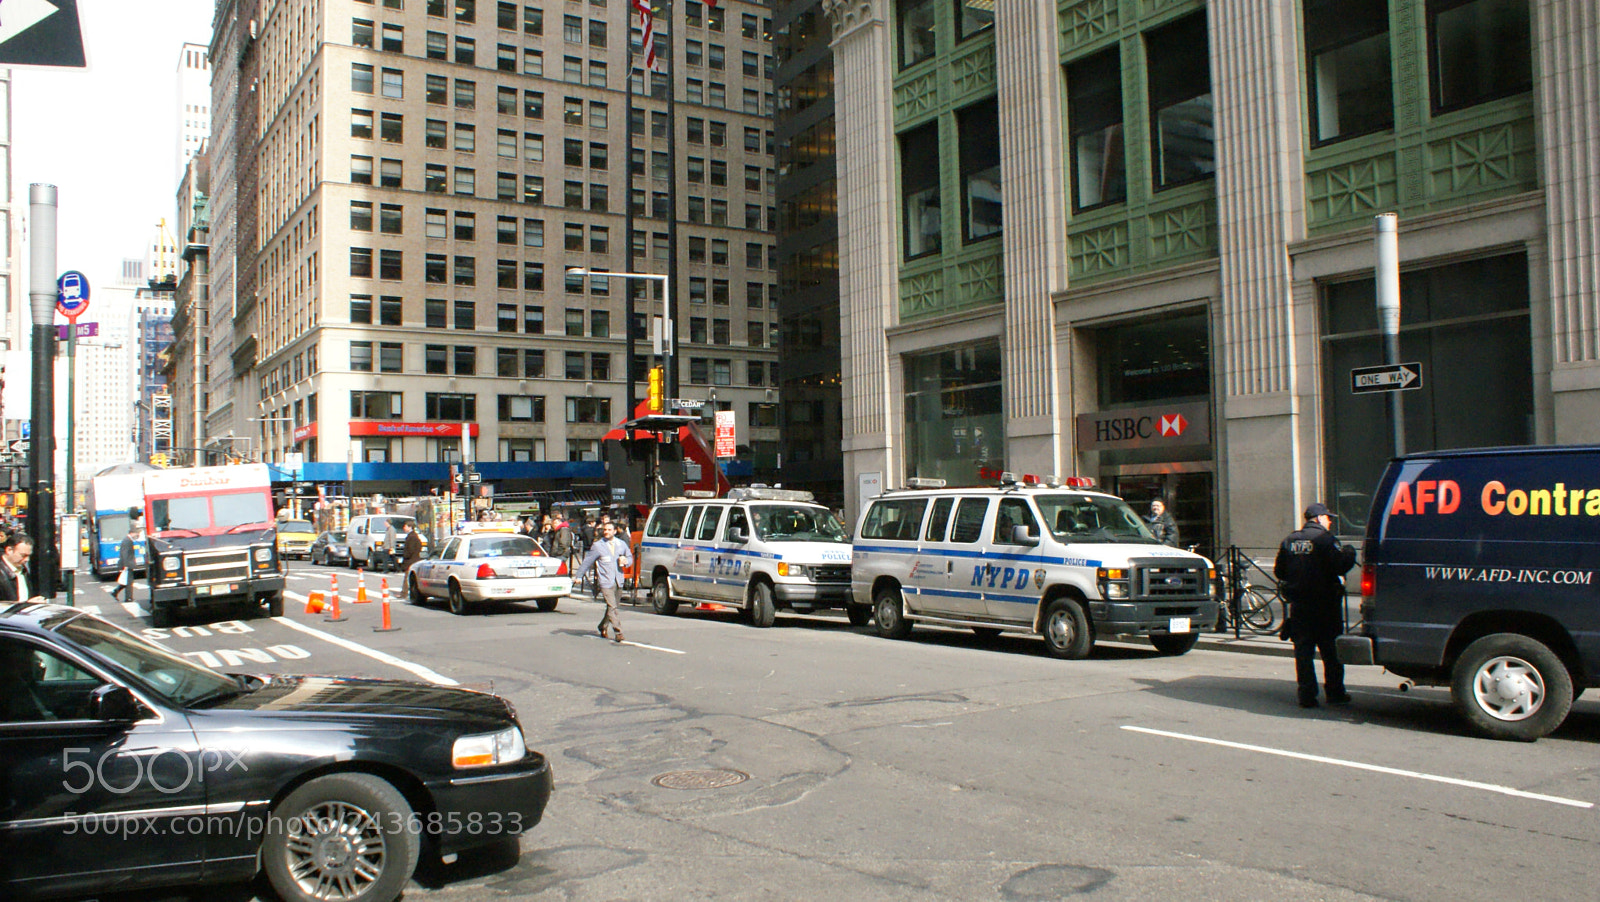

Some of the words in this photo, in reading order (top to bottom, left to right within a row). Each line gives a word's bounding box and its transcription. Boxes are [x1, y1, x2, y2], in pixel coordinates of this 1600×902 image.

[77, 325, 90, 335] M5
[1360, 374, 1380, 385] ONE
[1388, 371, 1410, 383] WAY
[378, 424, 395, 432] Bank
[404, 425, 434, 433] America
[1096, 416, 1152, 442] HSBC
[180, 477, 230, 488] Dunbar
[1391, 480, 1461, 515] AFD
[1481, 480, 1600, 516] Contra
[1290, 542, 1313, 552] NYPD
[709, 557, 742, 576] NYPD
[1064, 557, 1086, 566] POLICE
[970, 565, 1030, 590] NYPD
[1425, 567, 1592, 584] WWW.AFD-INC.COM
[141, 620, 256, 640] BUS
[182, 644, 311, 668] ONL
